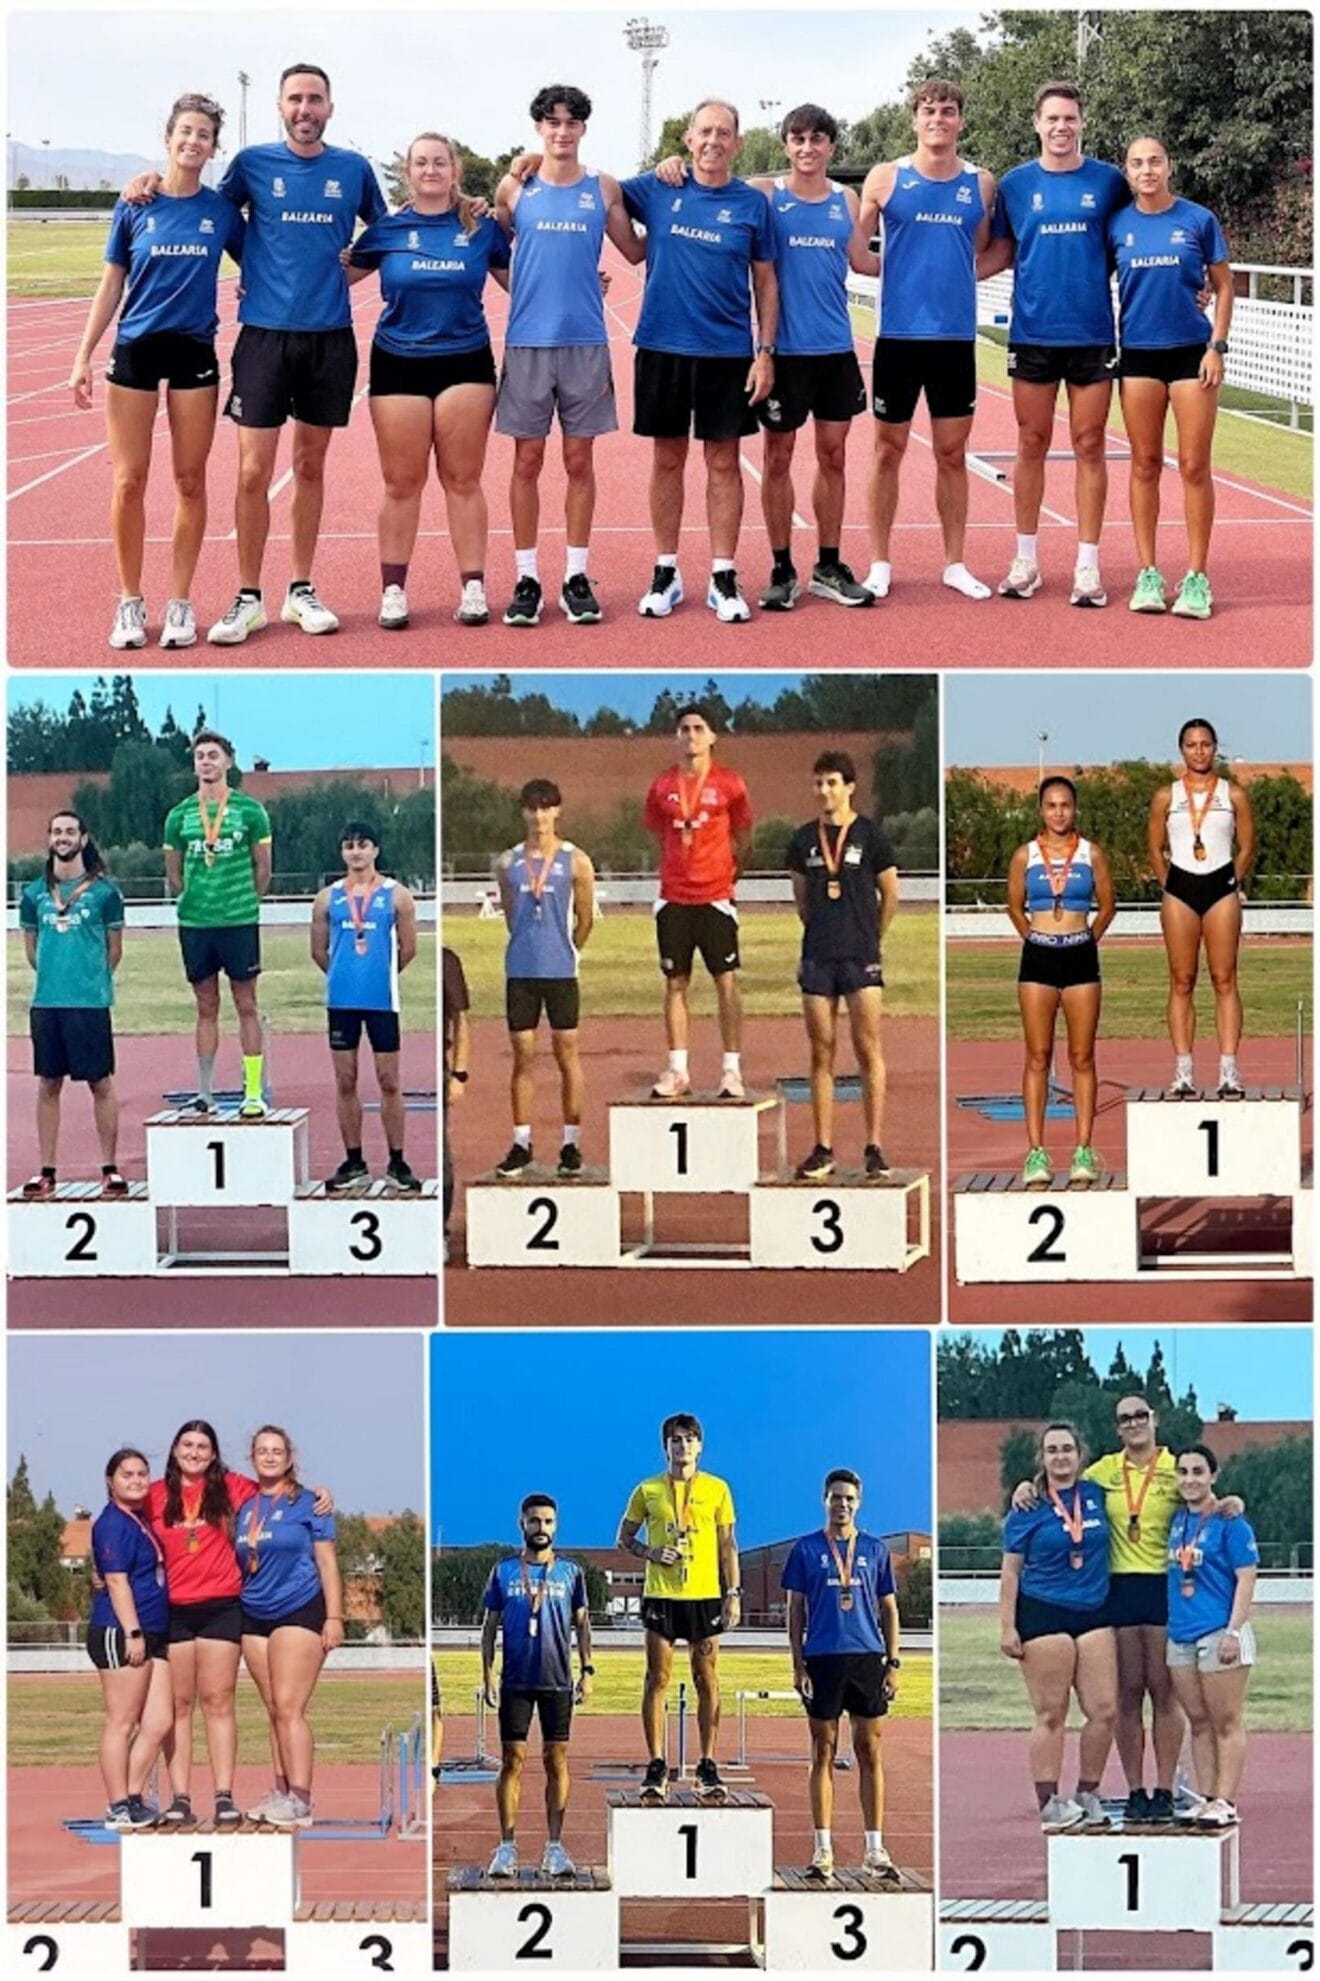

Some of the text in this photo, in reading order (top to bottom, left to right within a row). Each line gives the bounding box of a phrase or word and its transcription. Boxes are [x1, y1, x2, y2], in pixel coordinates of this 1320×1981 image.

[1029, 932, 1057, 945] PRO
[207, 1141, 225, 1189] 1
[670, 1123, 688, 1175] 1
[1199, 1121, 1219, 1177] 1
[65, 1212, 98, 1261] 2
[350, 1211, 382, 1261] 3
[527, 1198, 559, 1250] 2
[811, 1200, 844, 1254] 3
[1028, 1205, 1066, 1263] 2
[678, 1825, 698, 1879] 1
[192, 1853, 212, 1908] 1
[1119, 1855, 1139, 1911] 1
[516, 1904, 553, 1959] 2
[832, 1905, 867, 1961] 3
